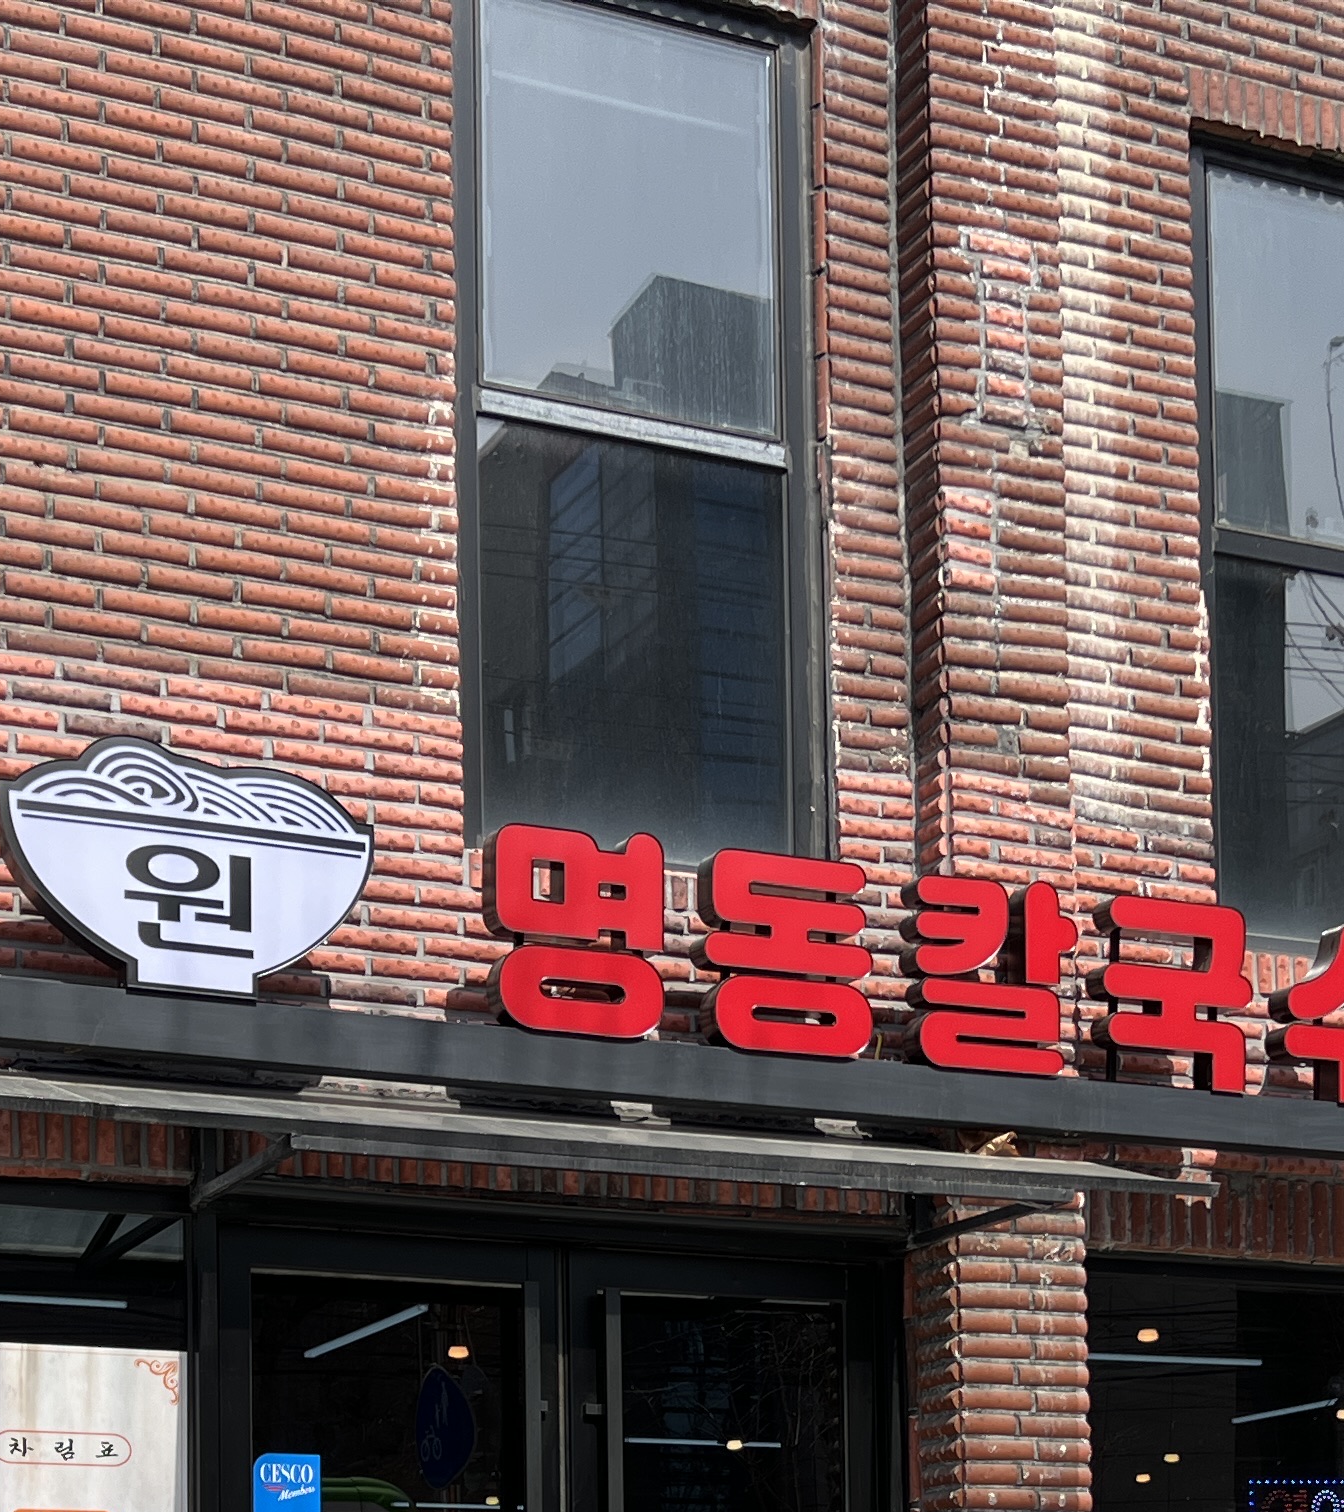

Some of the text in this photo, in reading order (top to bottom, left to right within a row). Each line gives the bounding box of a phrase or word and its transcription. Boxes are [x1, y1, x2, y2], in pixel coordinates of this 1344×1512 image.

[124, 843, 254, 960] 원
[260, 1463, 314, 1484] CESCO
[277, 1484, 316, 1501] Members
